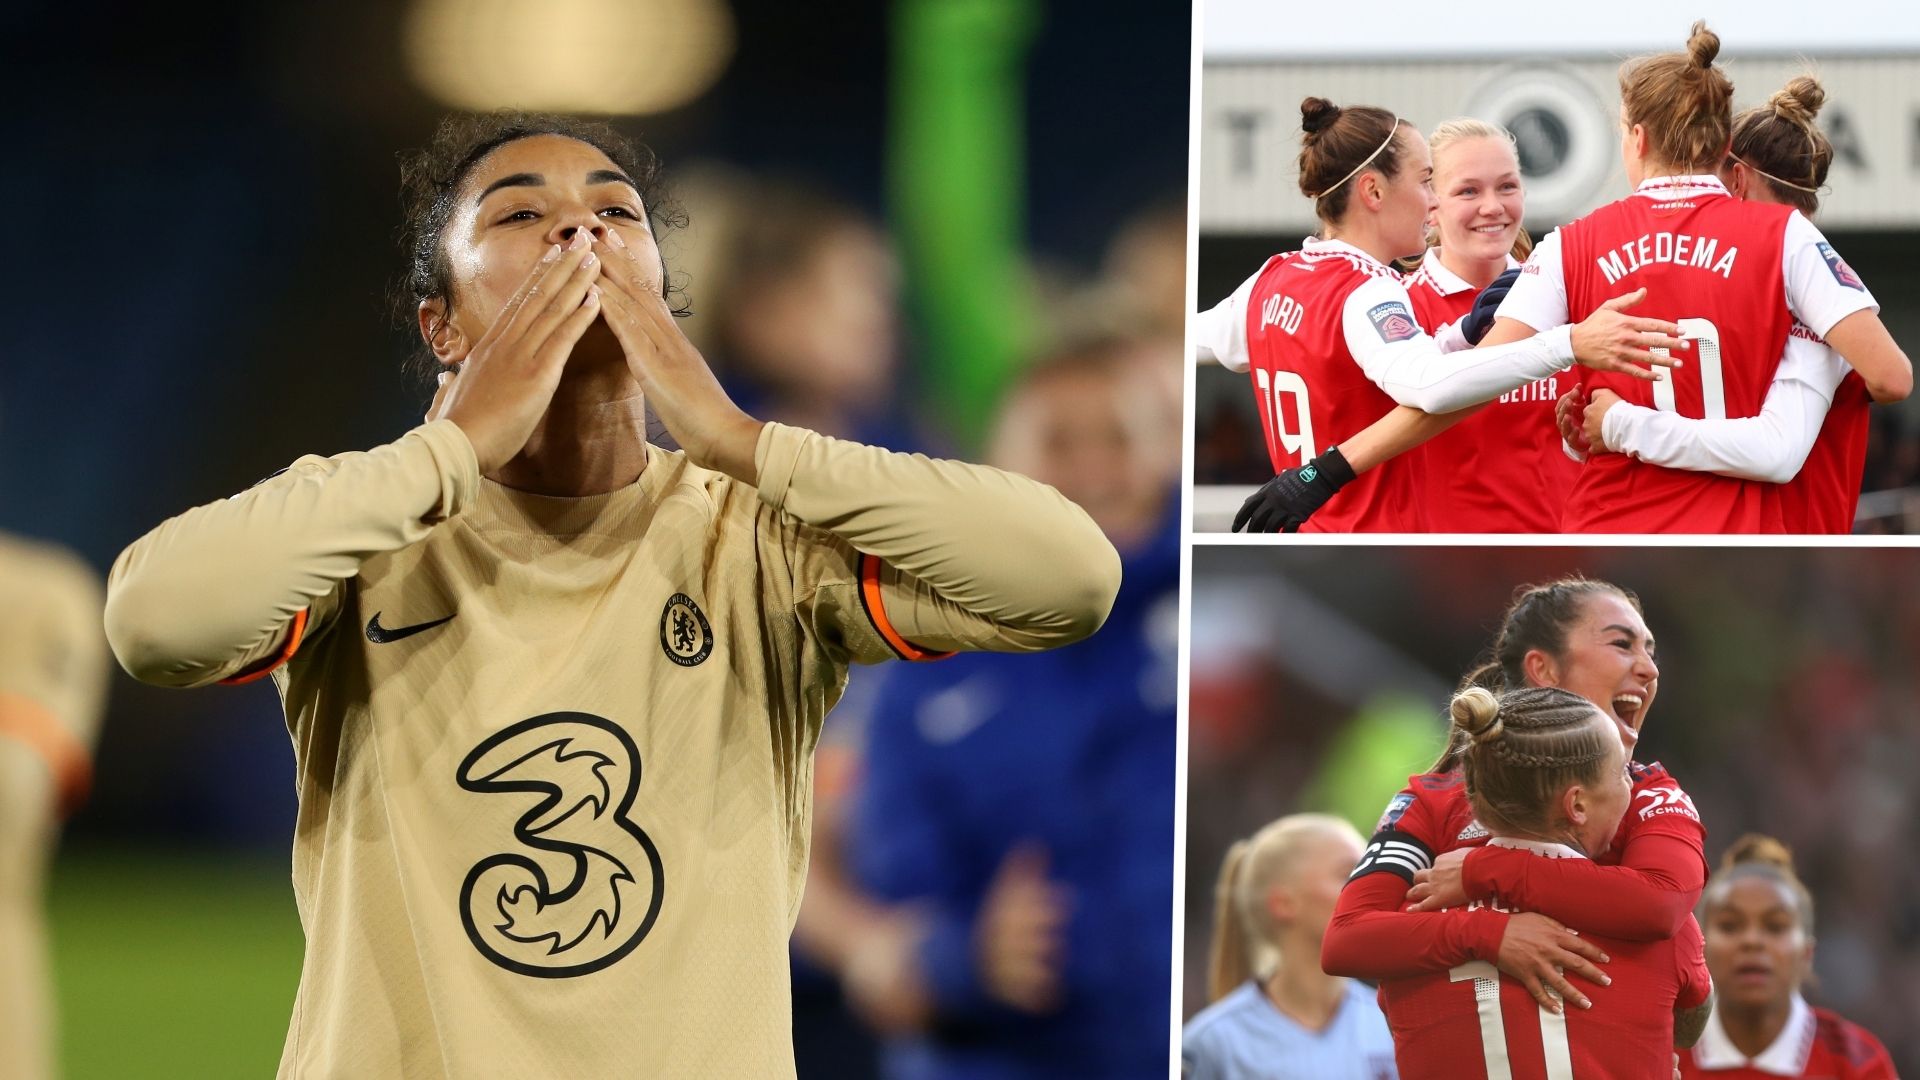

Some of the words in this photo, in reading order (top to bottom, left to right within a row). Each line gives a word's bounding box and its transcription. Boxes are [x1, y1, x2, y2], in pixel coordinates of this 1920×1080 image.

[1651, 201, 1697, 209] ARSENAL
[1597, 231, 1738, 285] MIEDEMA
[1256, 367, 1317, 468] 19
[668, 594, 698, 614] CHELSEA
[456, 711, 665, 979] 3
[1457, 829, 1489, 840] adidas
[1449, 961, 1575, 1080] 11
